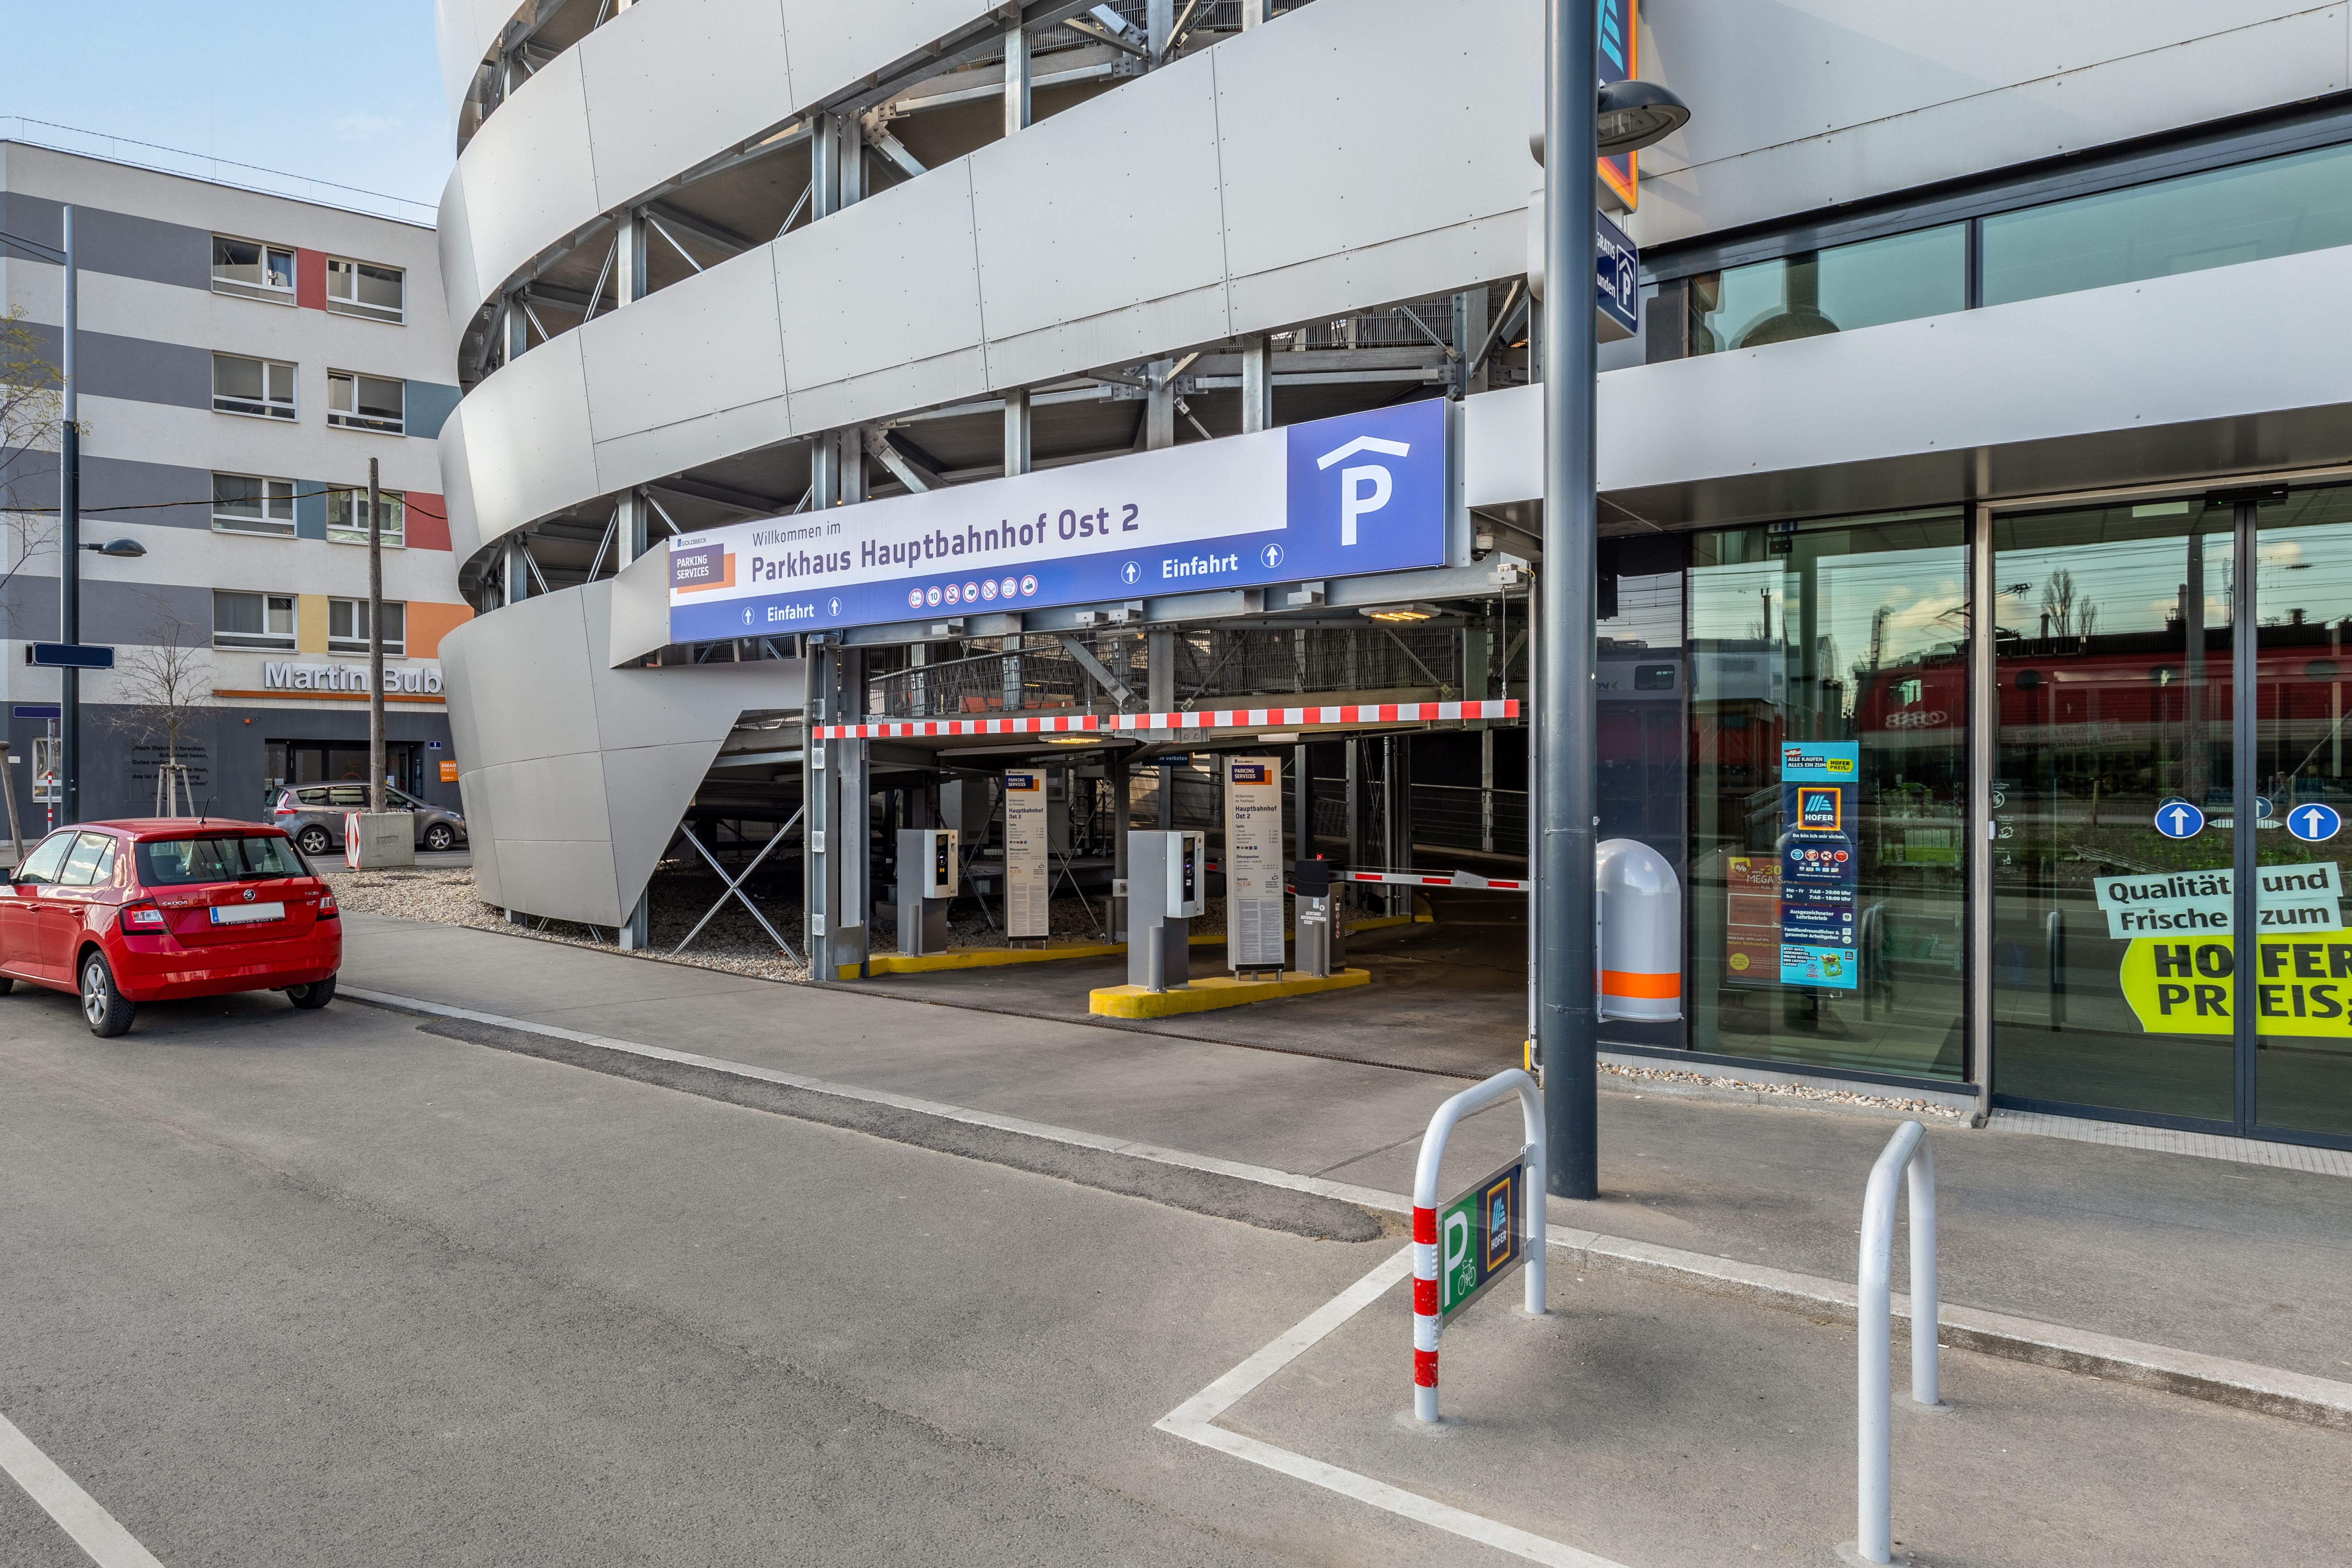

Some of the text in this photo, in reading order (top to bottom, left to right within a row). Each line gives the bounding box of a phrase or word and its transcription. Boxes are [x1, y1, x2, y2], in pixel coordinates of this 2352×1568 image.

[1623, 271, 1631, 306] P
[1341, 464, 1393, 546] P
[682, 537, 707, 546] GOLDBECK
[752, 503, 1139, 582] Parkhaus Hauptbahnhof Ost 2
[753, 520, 841, 547] Willkommen im
[677, 555, 707, 568] PARKING
[677, 566, 709, 580] SERVICES
[1162, 554, 1239, 579] Einfahrt
[930, 592, 938, 601] 10
[767, 604, 814, 623] Einfahrt
[264, 661, 444, 693] Martin Bub
[1747, 874, 1774, 884] MEGA
[2108, 868, 2329, 904] Qualität und
[2120, 907, 2330, 930] Frische zum
[2153, 943, 2352, 978] HOFER
[1491, 1230, 1507, 1251] HOFER
[1444, 1211, 1468, 1308] P
